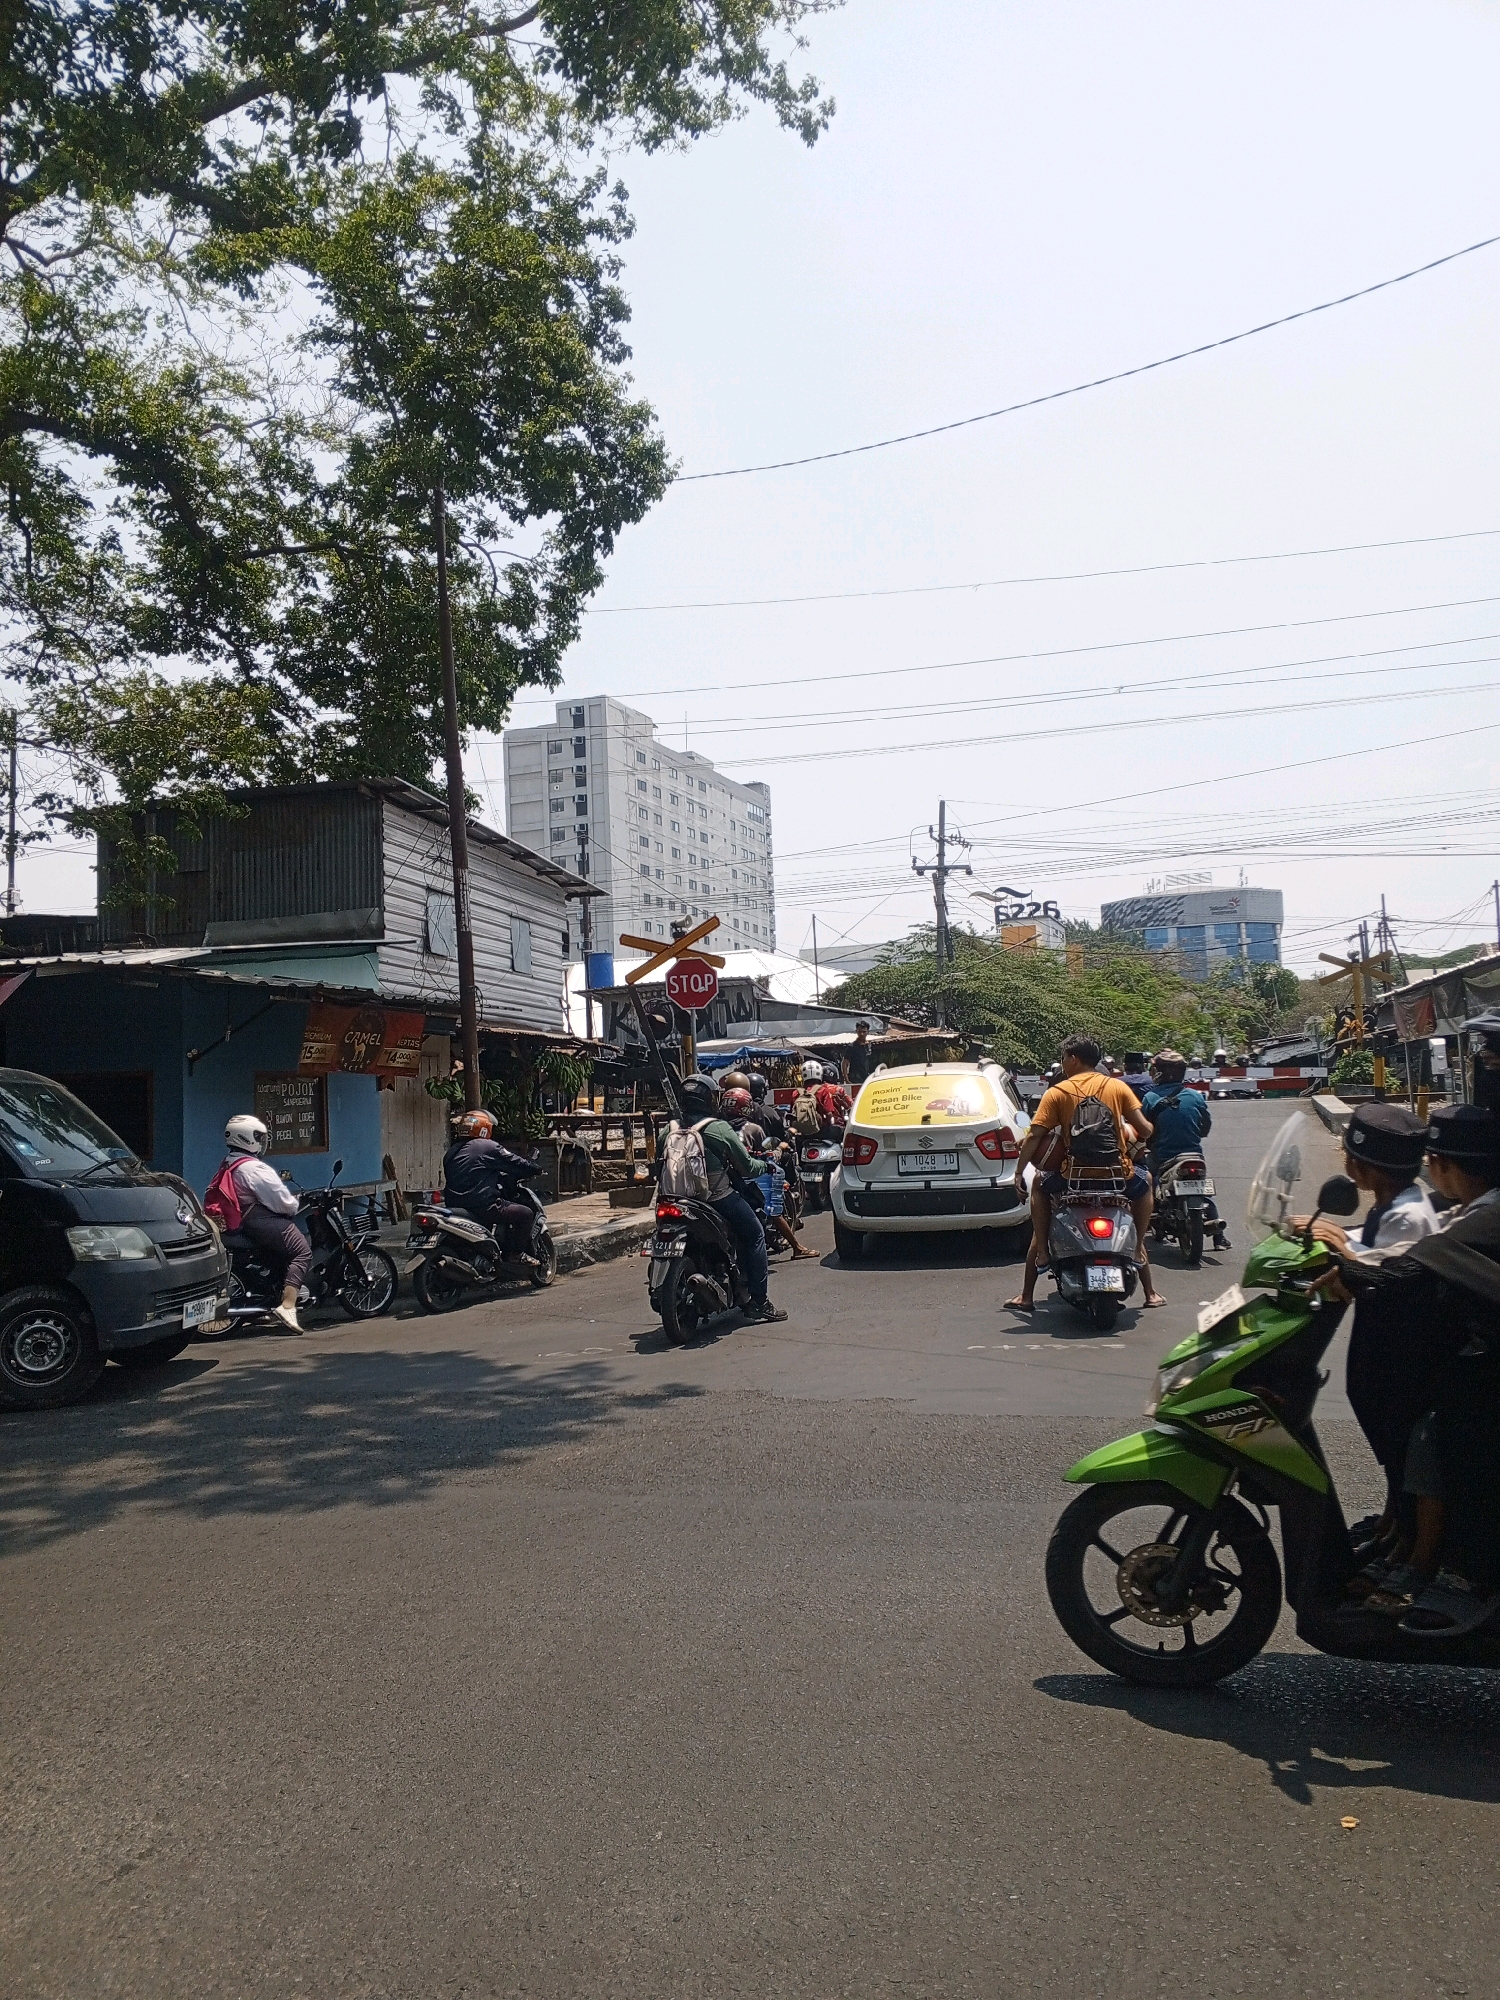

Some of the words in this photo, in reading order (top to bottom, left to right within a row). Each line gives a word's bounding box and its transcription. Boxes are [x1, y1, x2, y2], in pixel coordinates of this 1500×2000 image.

[669, 973, 714, 994] STOP
[344, 1031, 381, 1046] CAMEL
[872, 1086, 902, 1095] maxim
[871, 1096, 899, 1106] Pesan
[901, 1094, 922, 1102] Bike
[870, 1105, 891, 1114] atau
[893, 1103, 909, 1111] Car
[901, 1154, 907, 1166] N
[914, 1153, 936, 1165] 1048
[943, 1153, 955, 1165] ID
[1204, 1405, 1260, 1422] HONDA
